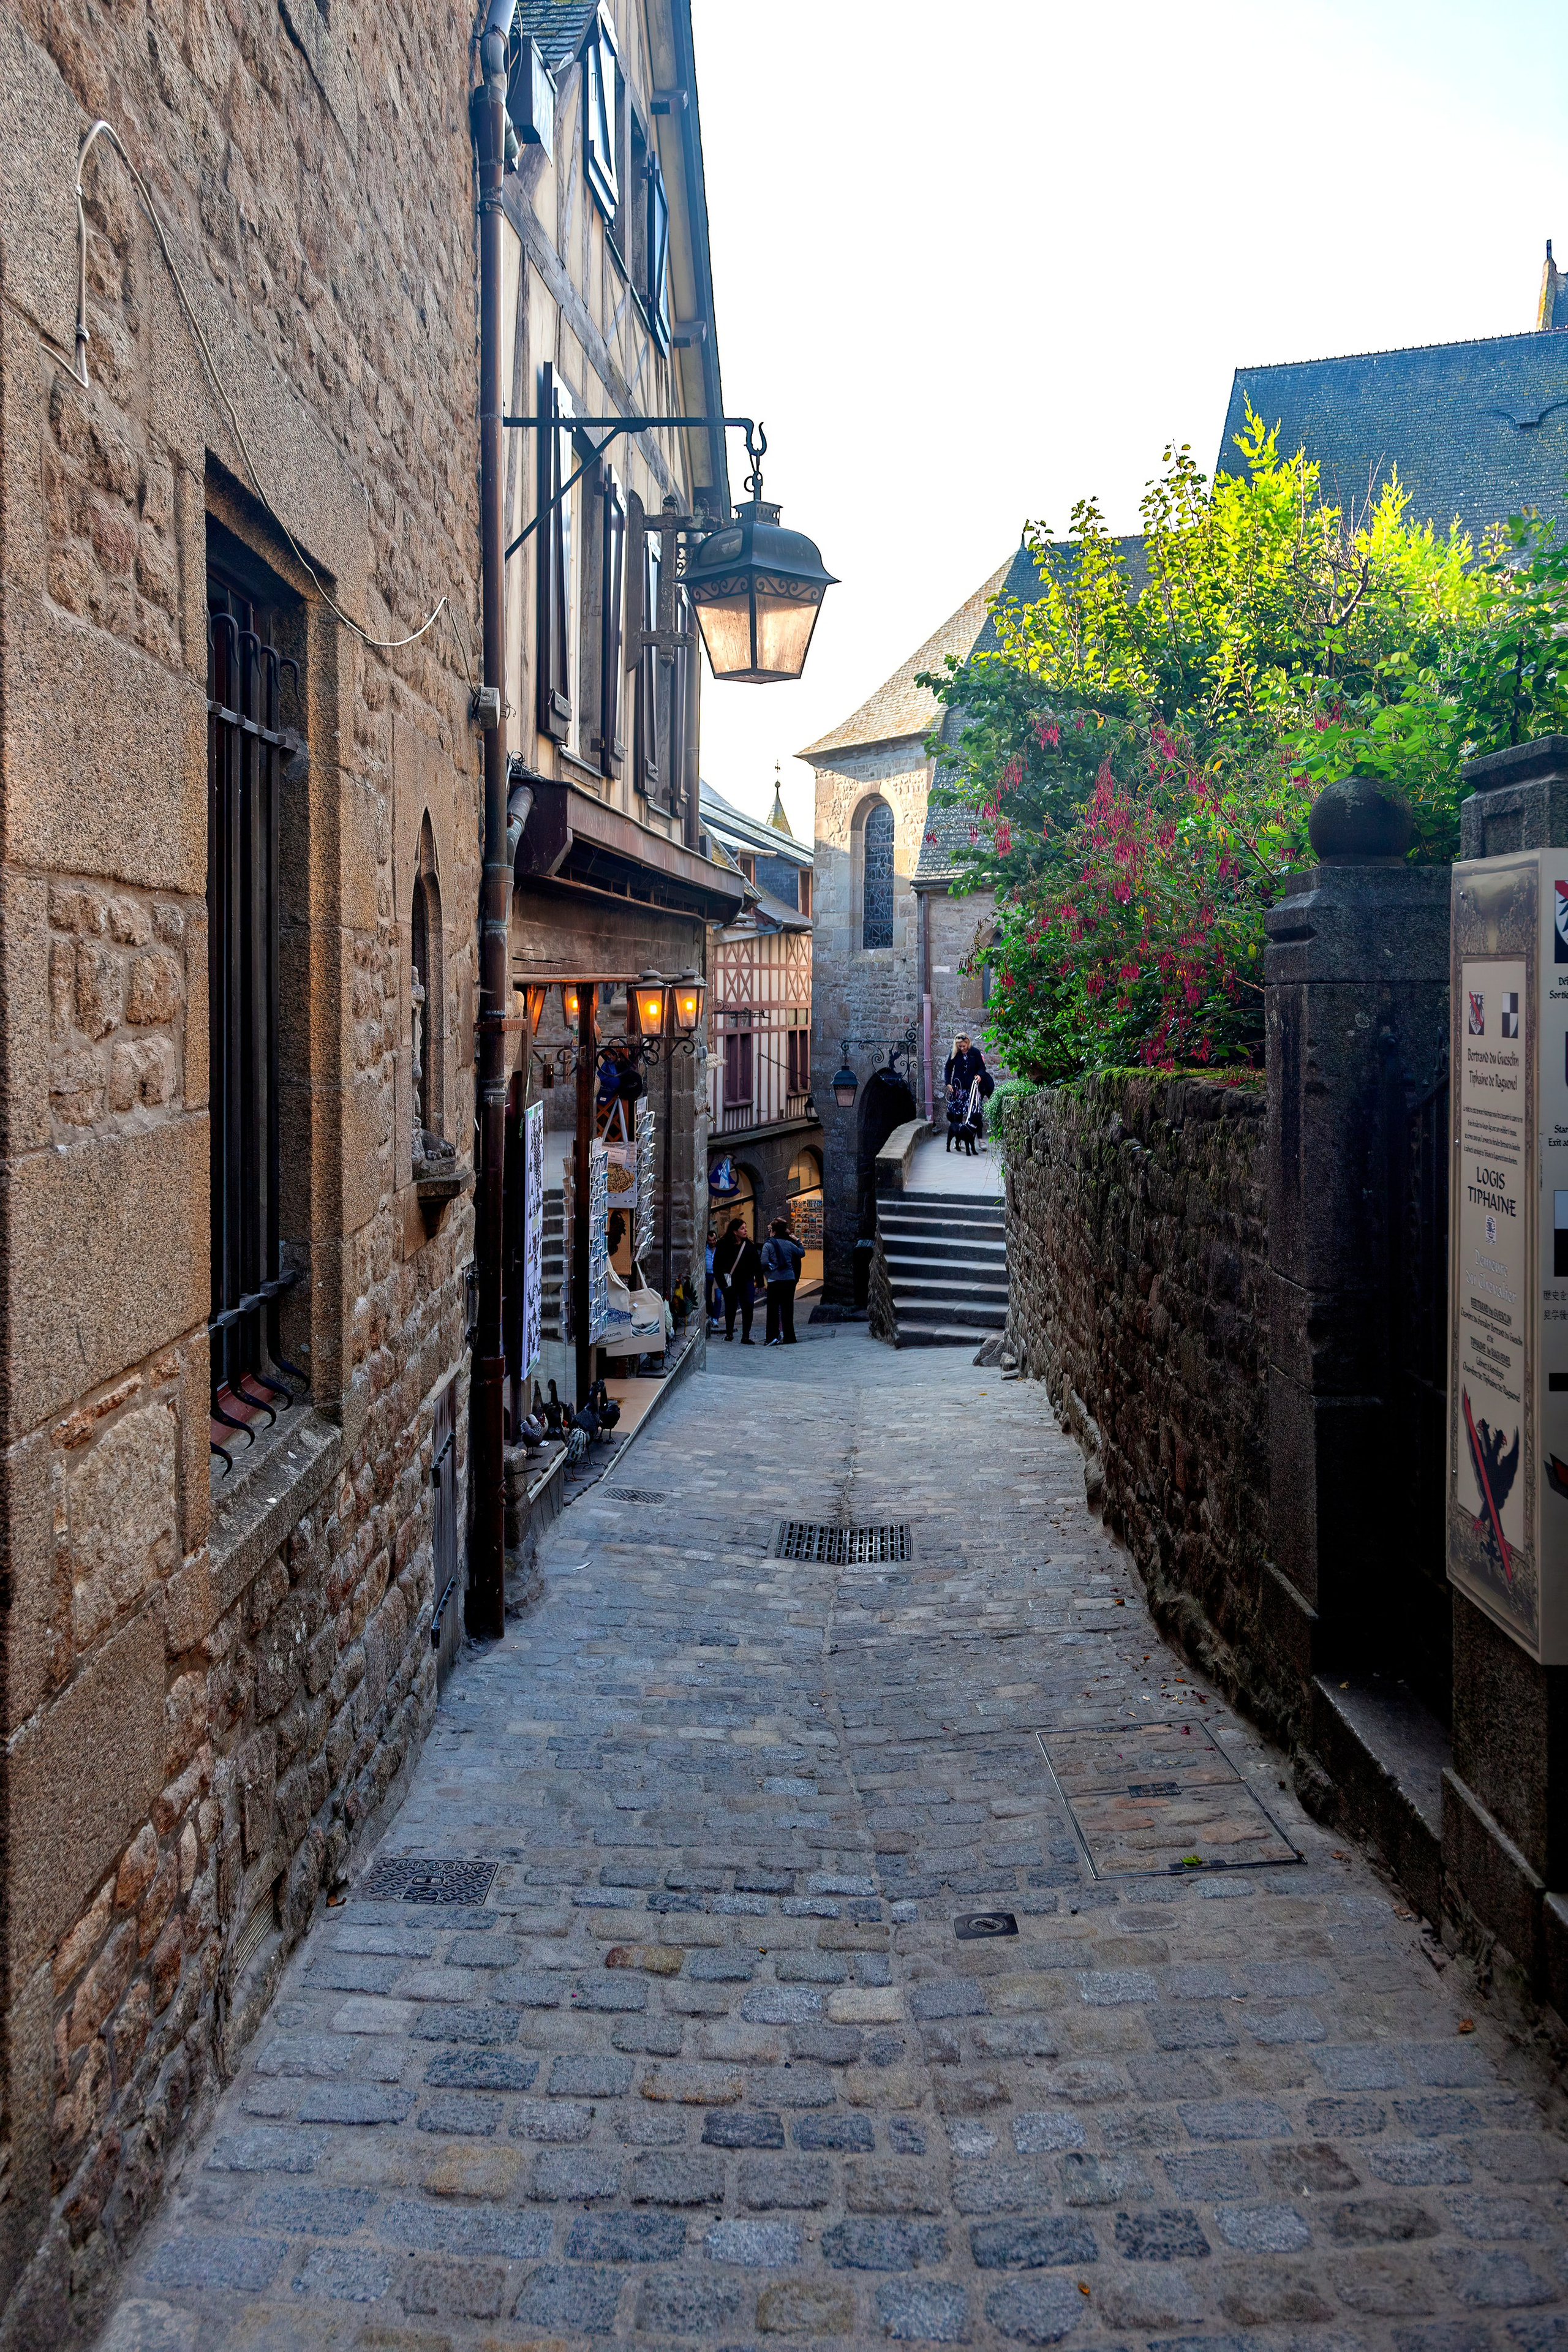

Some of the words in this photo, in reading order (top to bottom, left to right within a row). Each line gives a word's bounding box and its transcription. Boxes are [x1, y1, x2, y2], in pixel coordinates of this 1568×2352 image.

[1468, 1048, 1488, 1063] Bertrand
[1490, 1052, 1496, 1064] du
[1498, 1050, 1519, 1066] Guesclin
[1469, 1069, 1488, 1088] Tiphaine
[1489, 1074, 1494, 1087] de
[1495, 1074, 1518, 1092] Raguenel
[1548, 1137, 1561, 1147] Exit
[1476, 1166, 1506, 1190] LOGIS
[1467, 1186, 1517, 1218] TIPHAINE
